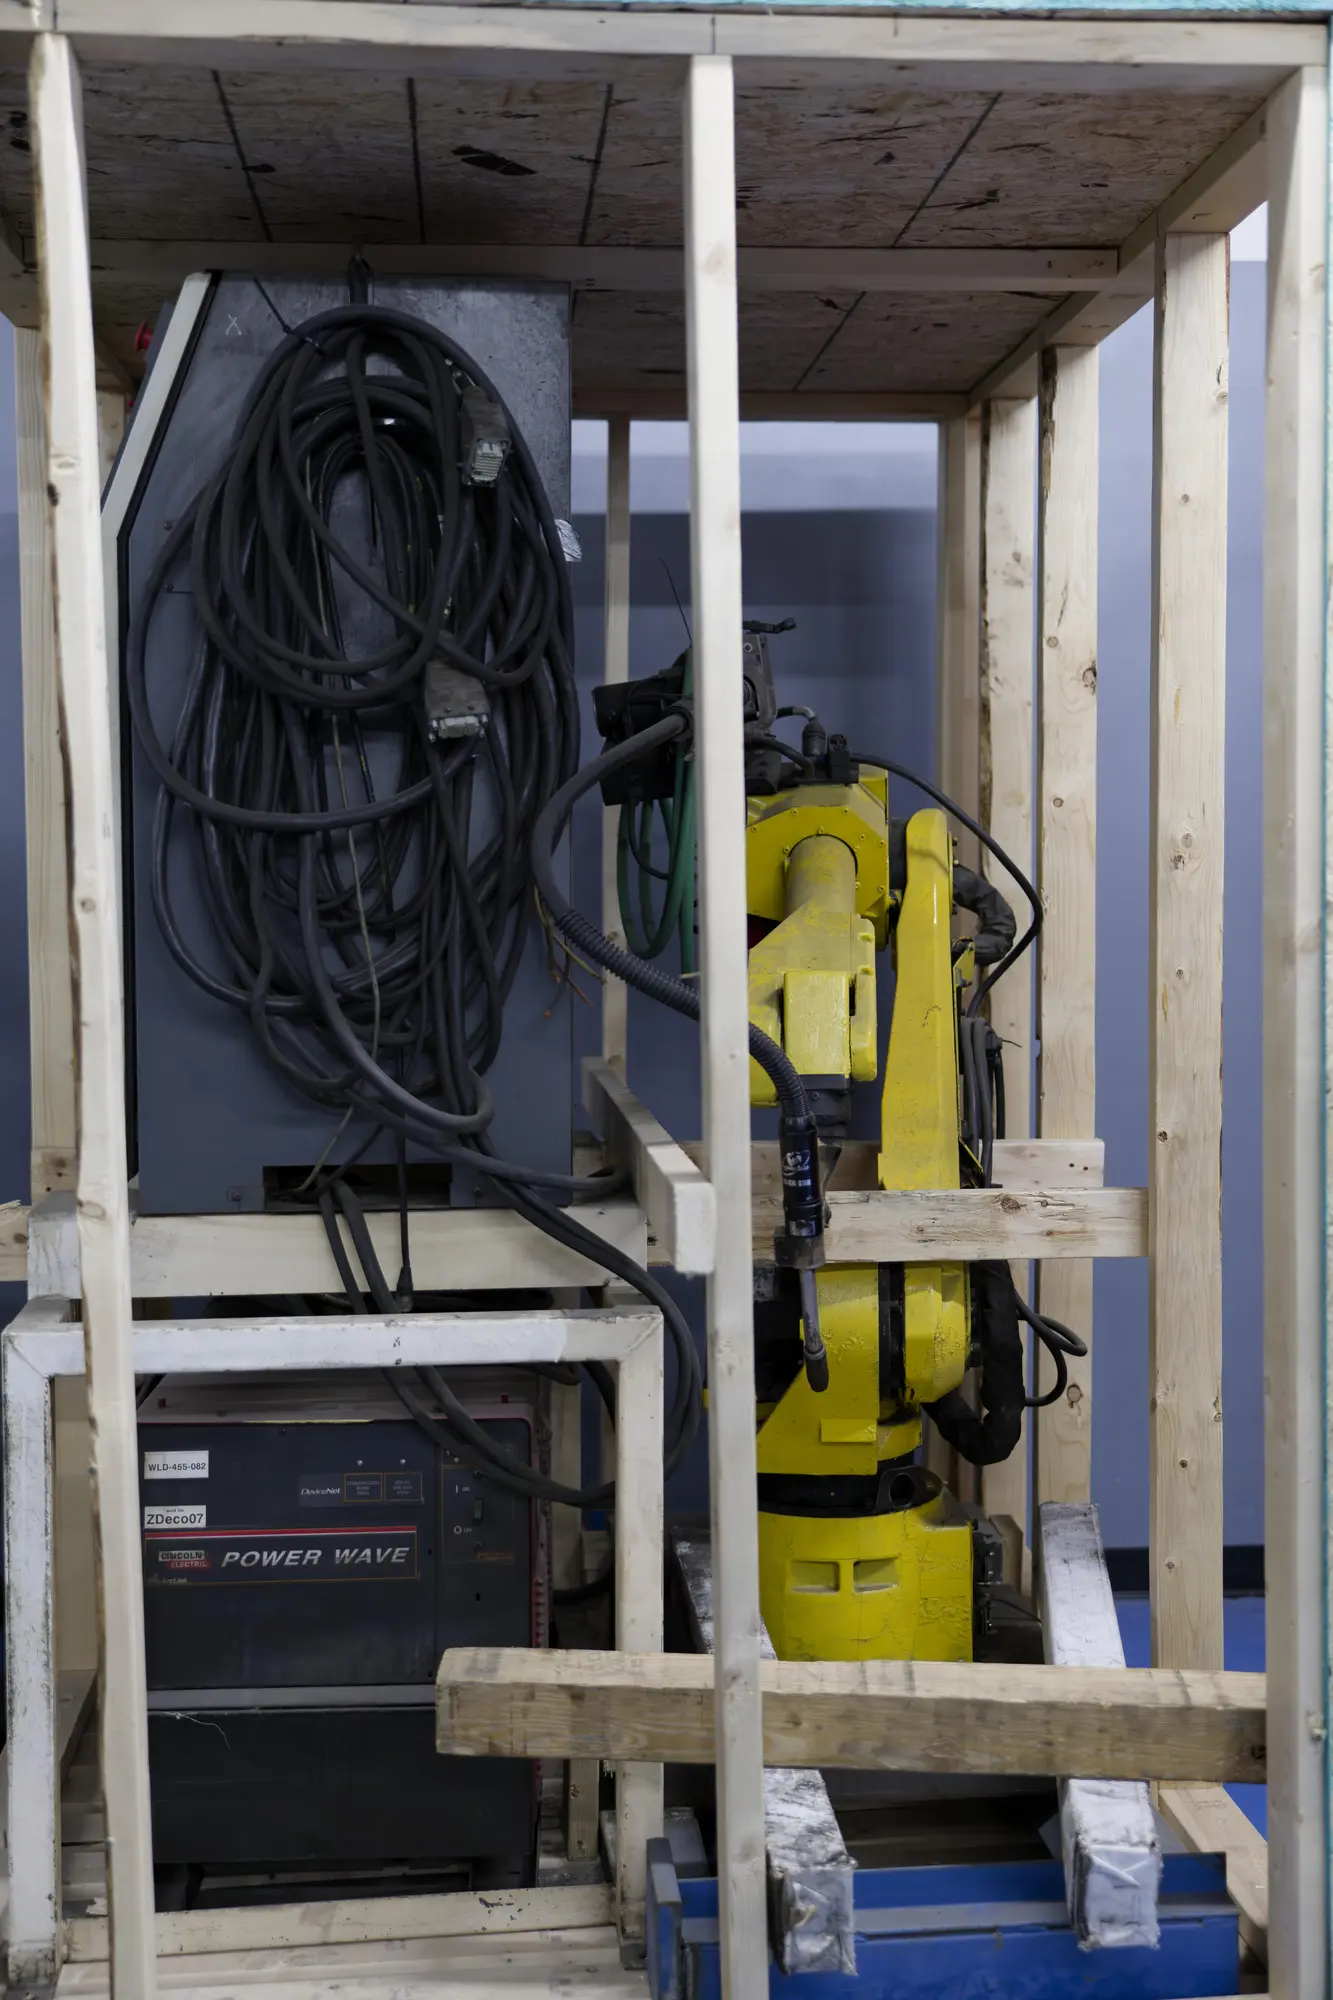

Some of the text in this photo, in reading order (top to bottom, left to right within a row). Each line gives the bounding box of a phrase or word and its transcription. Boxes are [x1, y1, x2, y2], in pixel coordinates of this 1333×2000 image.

[148, 1462, 207, 1472] WLD-455-082
[300, 1487, 341, 1496] DeviceNet
[146, 1513, 204, 1525] ZDeco07
[160, 1551, 202, 1560] LINCOLN
[221, 1547, 410, 1568] POWER WAVE
[170, 1560, 208, 1569] ELECTRIC
